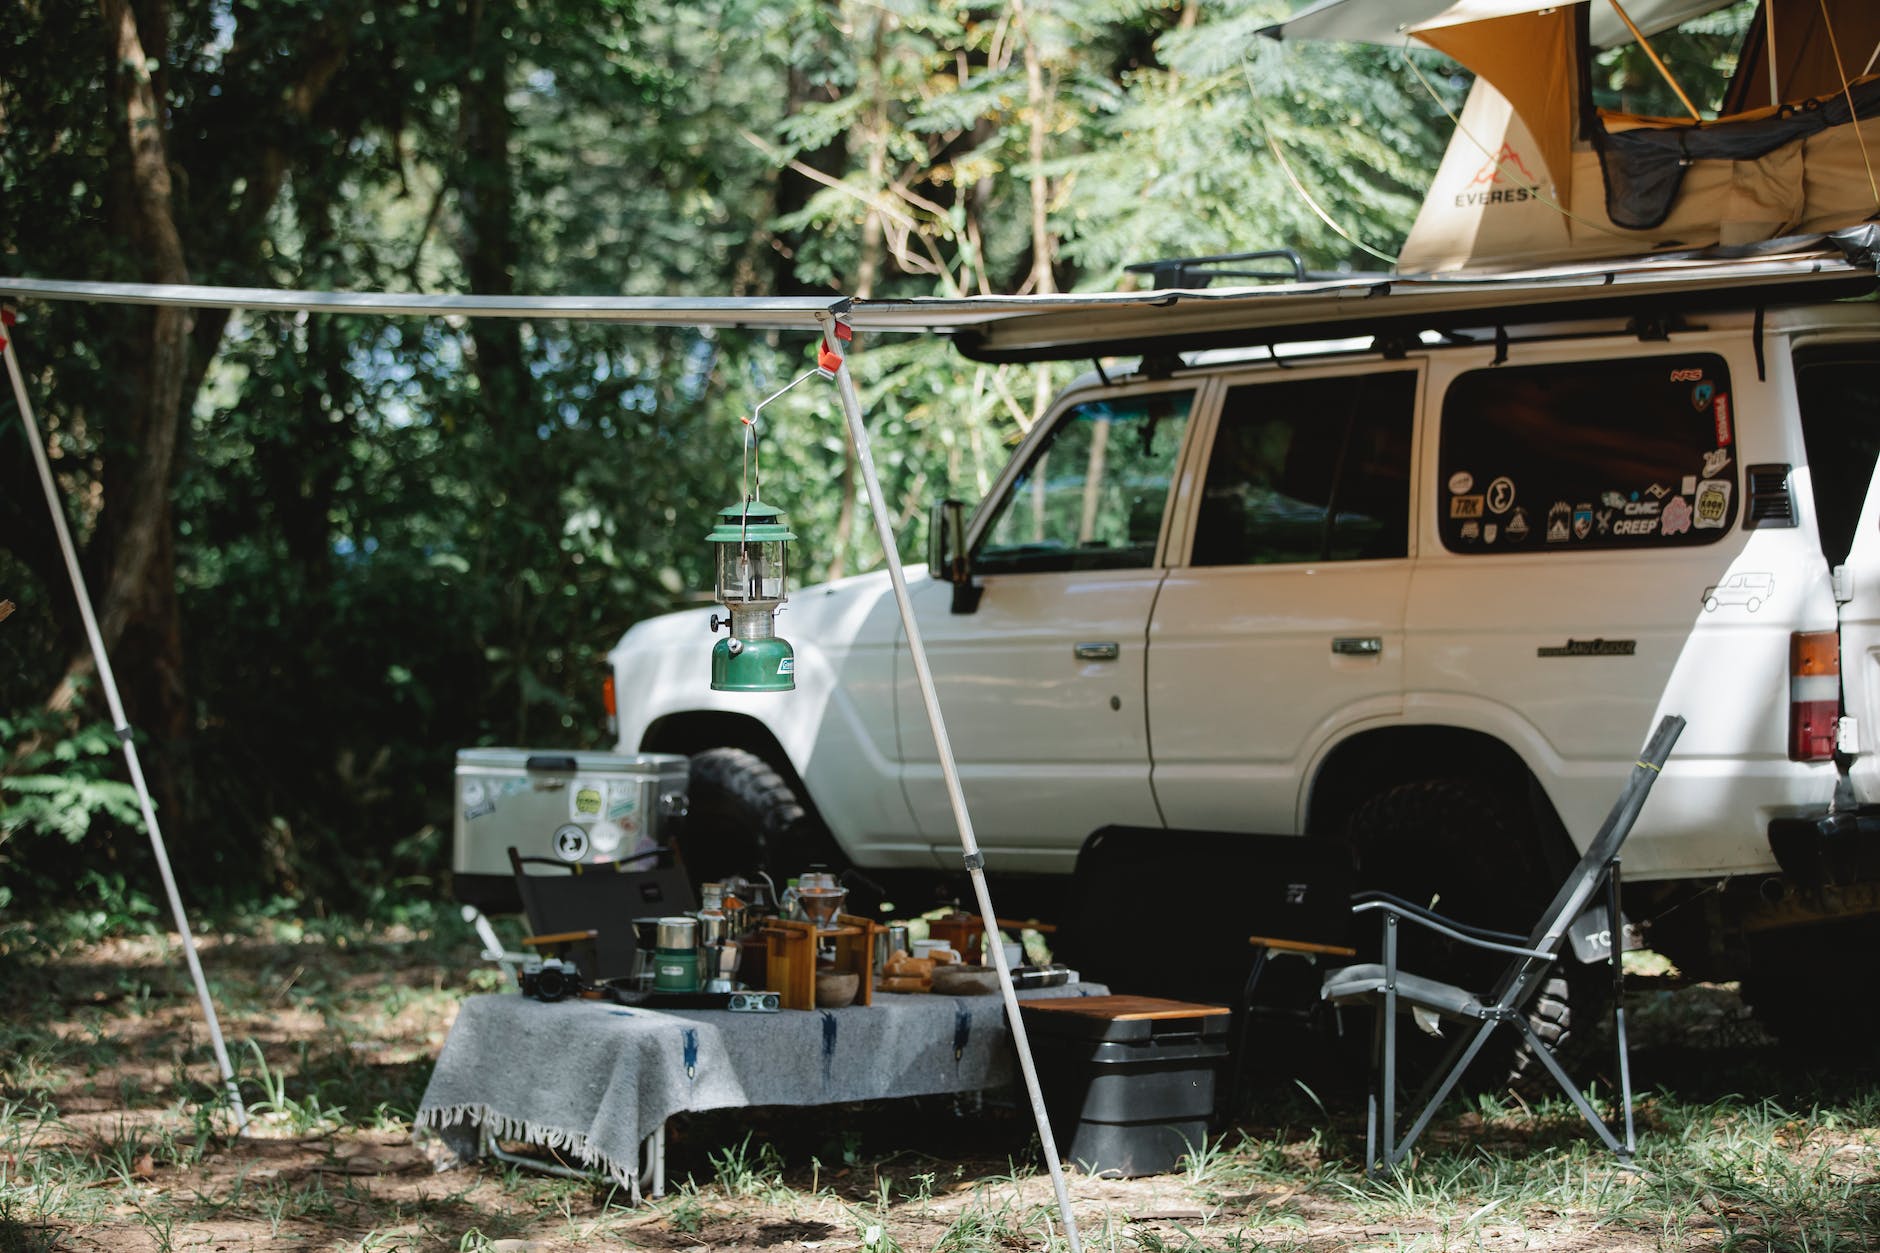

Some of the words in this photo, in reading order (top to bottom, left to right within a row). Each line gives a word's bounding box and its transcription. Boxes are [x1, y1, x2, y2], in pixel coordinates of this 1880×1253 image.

[1455, 186, 1540, 207] EVEREST
[1456, 498, 1479, 514] TRK
[1613, 520, 1656, 535] CREEP
